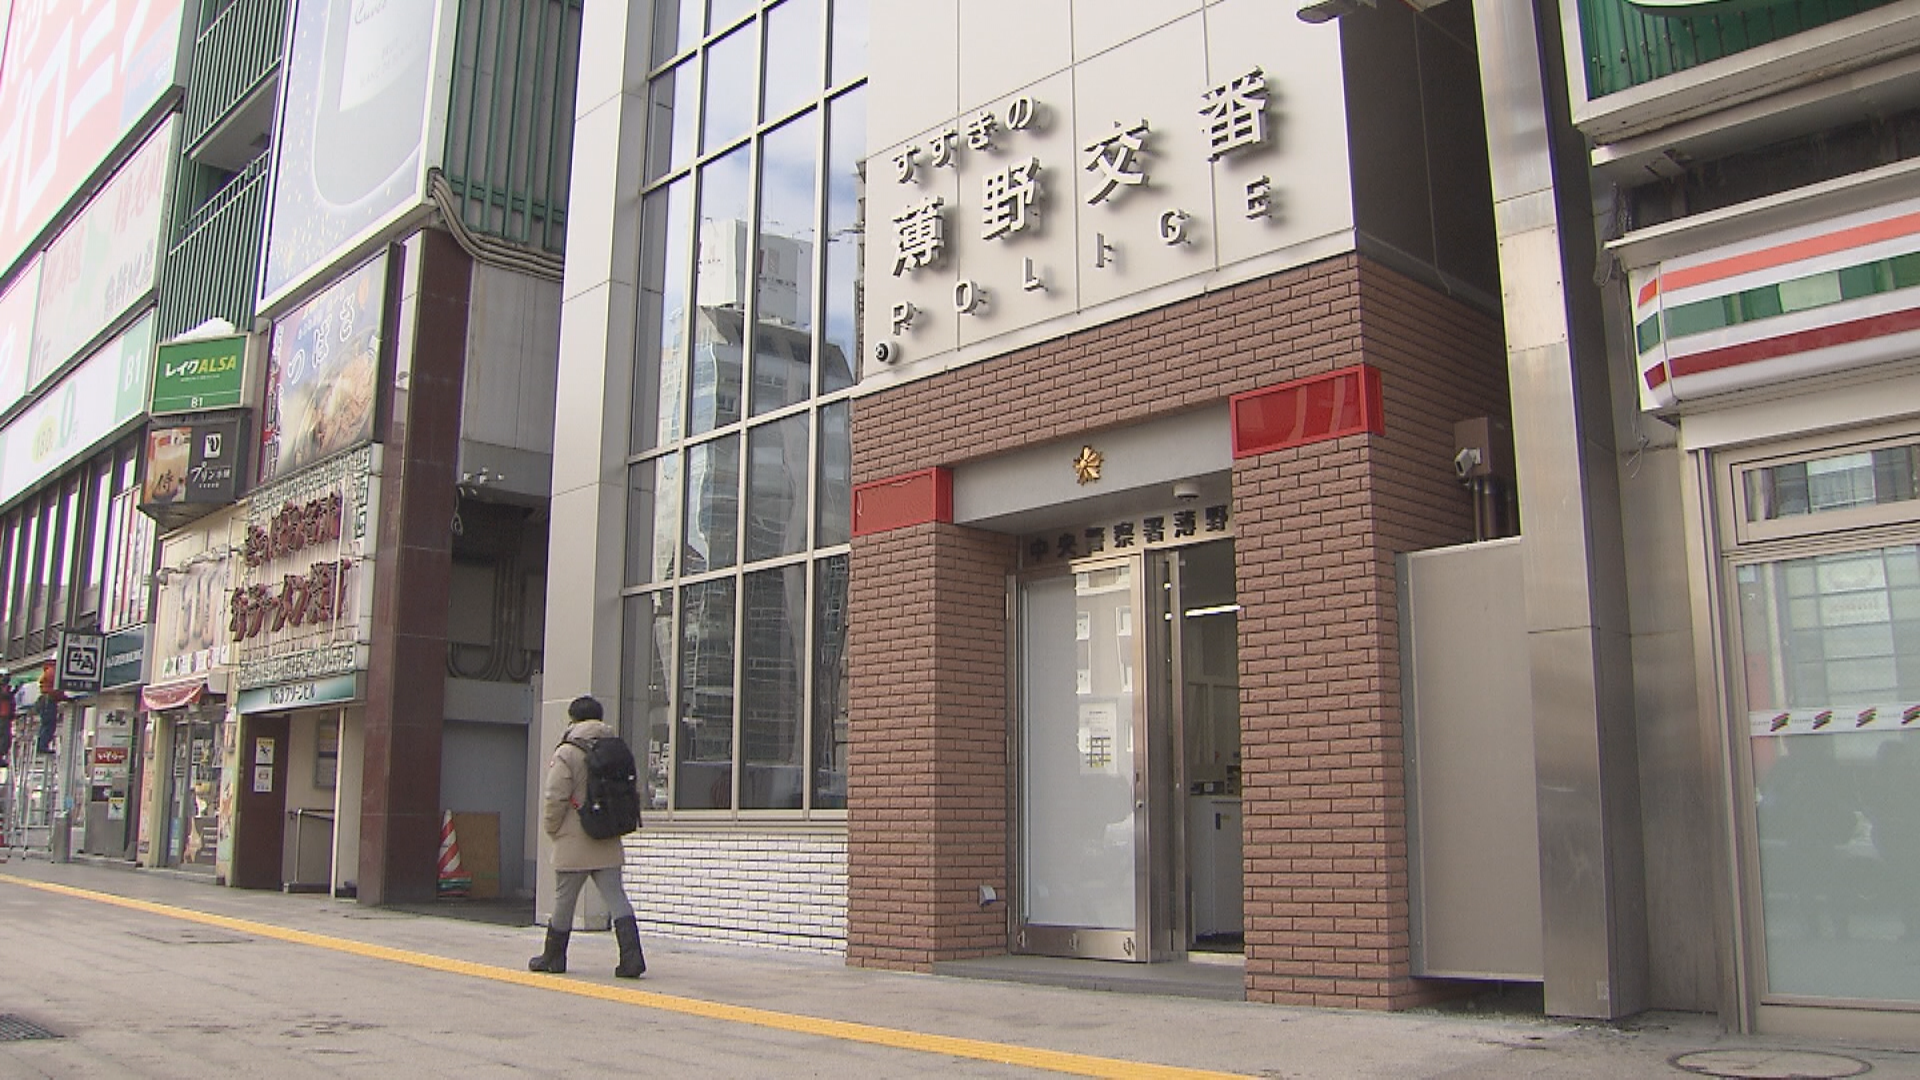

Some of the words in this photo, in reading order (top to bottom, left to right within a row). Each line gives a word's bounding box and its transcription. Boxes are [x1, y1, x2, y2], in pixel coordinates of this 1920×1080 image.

[893, 96, 1041, 185] すすきの
[891, 66, 1269, 277] 薄野交番
[891, 175, 1272, 336] POLICE
[124, 357, 142, 393] B1
[165, 355, 237, 378] レイクALSA
[191, 397, 203, 408] B1
[71, 651, 93, 671] 牛角
